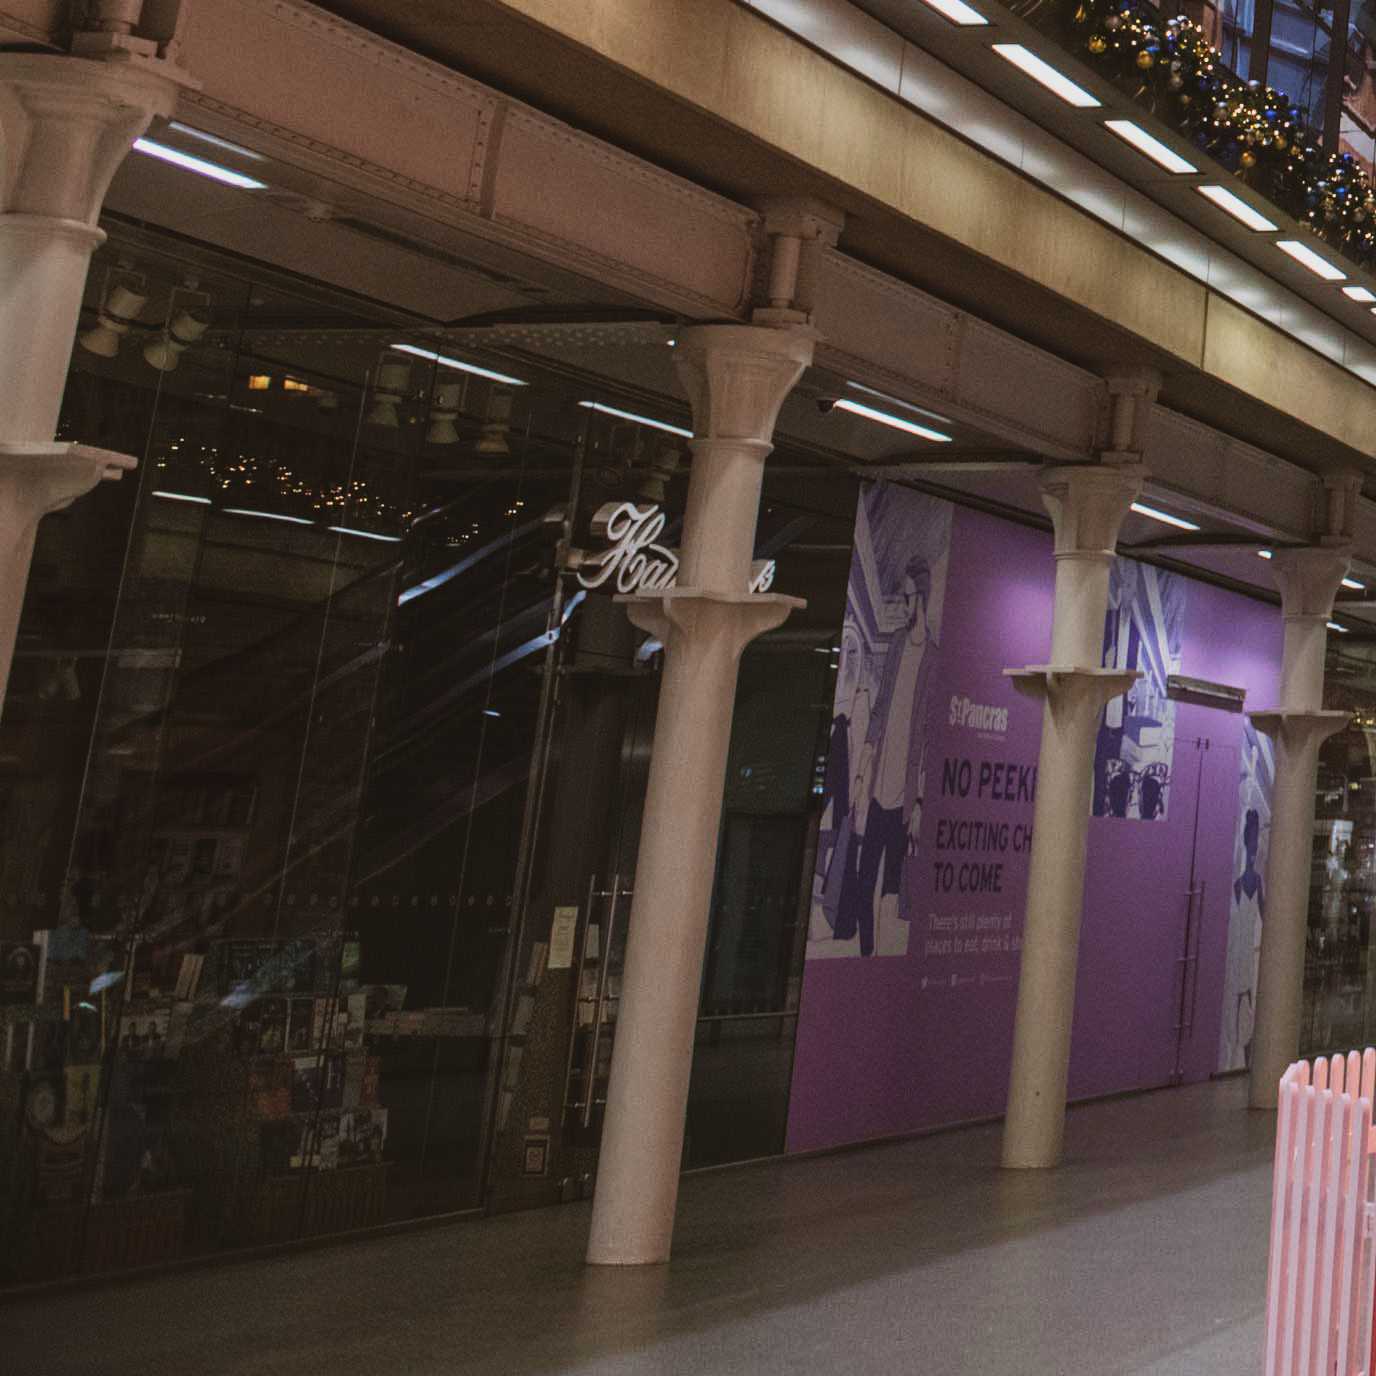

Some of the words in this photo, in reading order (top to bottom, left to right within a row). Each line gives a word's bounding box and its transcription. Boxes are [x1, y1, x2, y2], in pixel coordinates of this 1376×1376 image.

[941, 757, 972, 798] NO
[978, 761, 1037, 803] PEEKI
[935, 819, 1008, 852] EXCITING
[934, 862, 954, 892] TO
[958, 862, 1003, 893] COME
